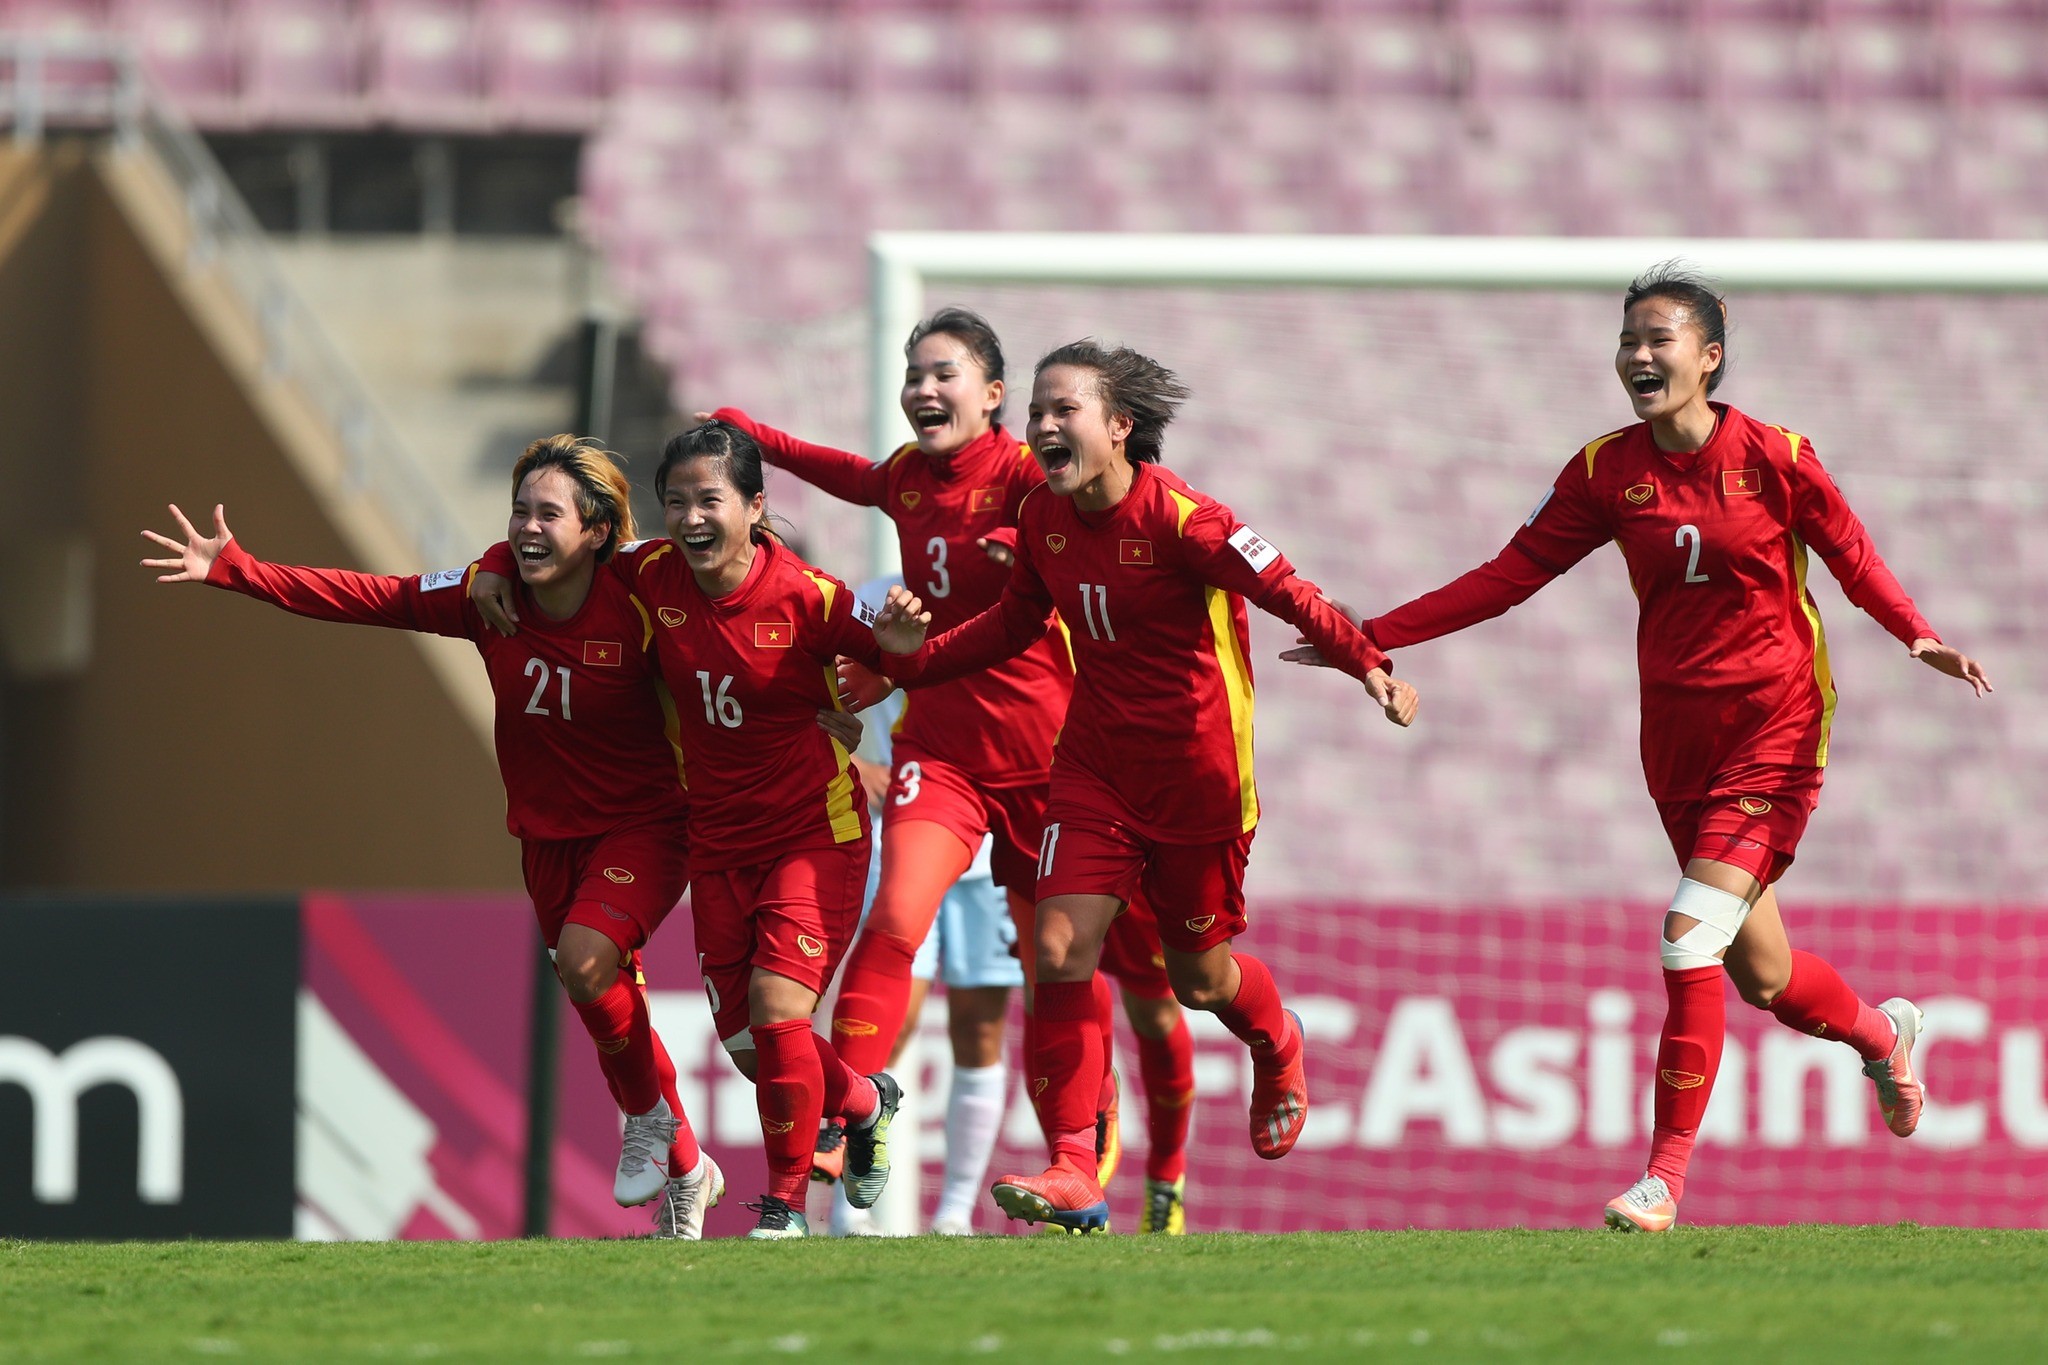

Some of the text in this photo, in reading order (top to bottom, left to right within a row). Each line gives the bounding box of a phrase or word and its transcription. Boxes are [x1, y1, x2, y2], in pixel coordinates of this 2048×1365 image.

[926, 536, 951, 598] 3
[1675, 524, 1709, 583] 2
[1079, 583, 1116, 642] 11
[523, 657, 572, 721] 21
[696, 670, 743, 728] 16
[895, 761, 921, 806] 3
